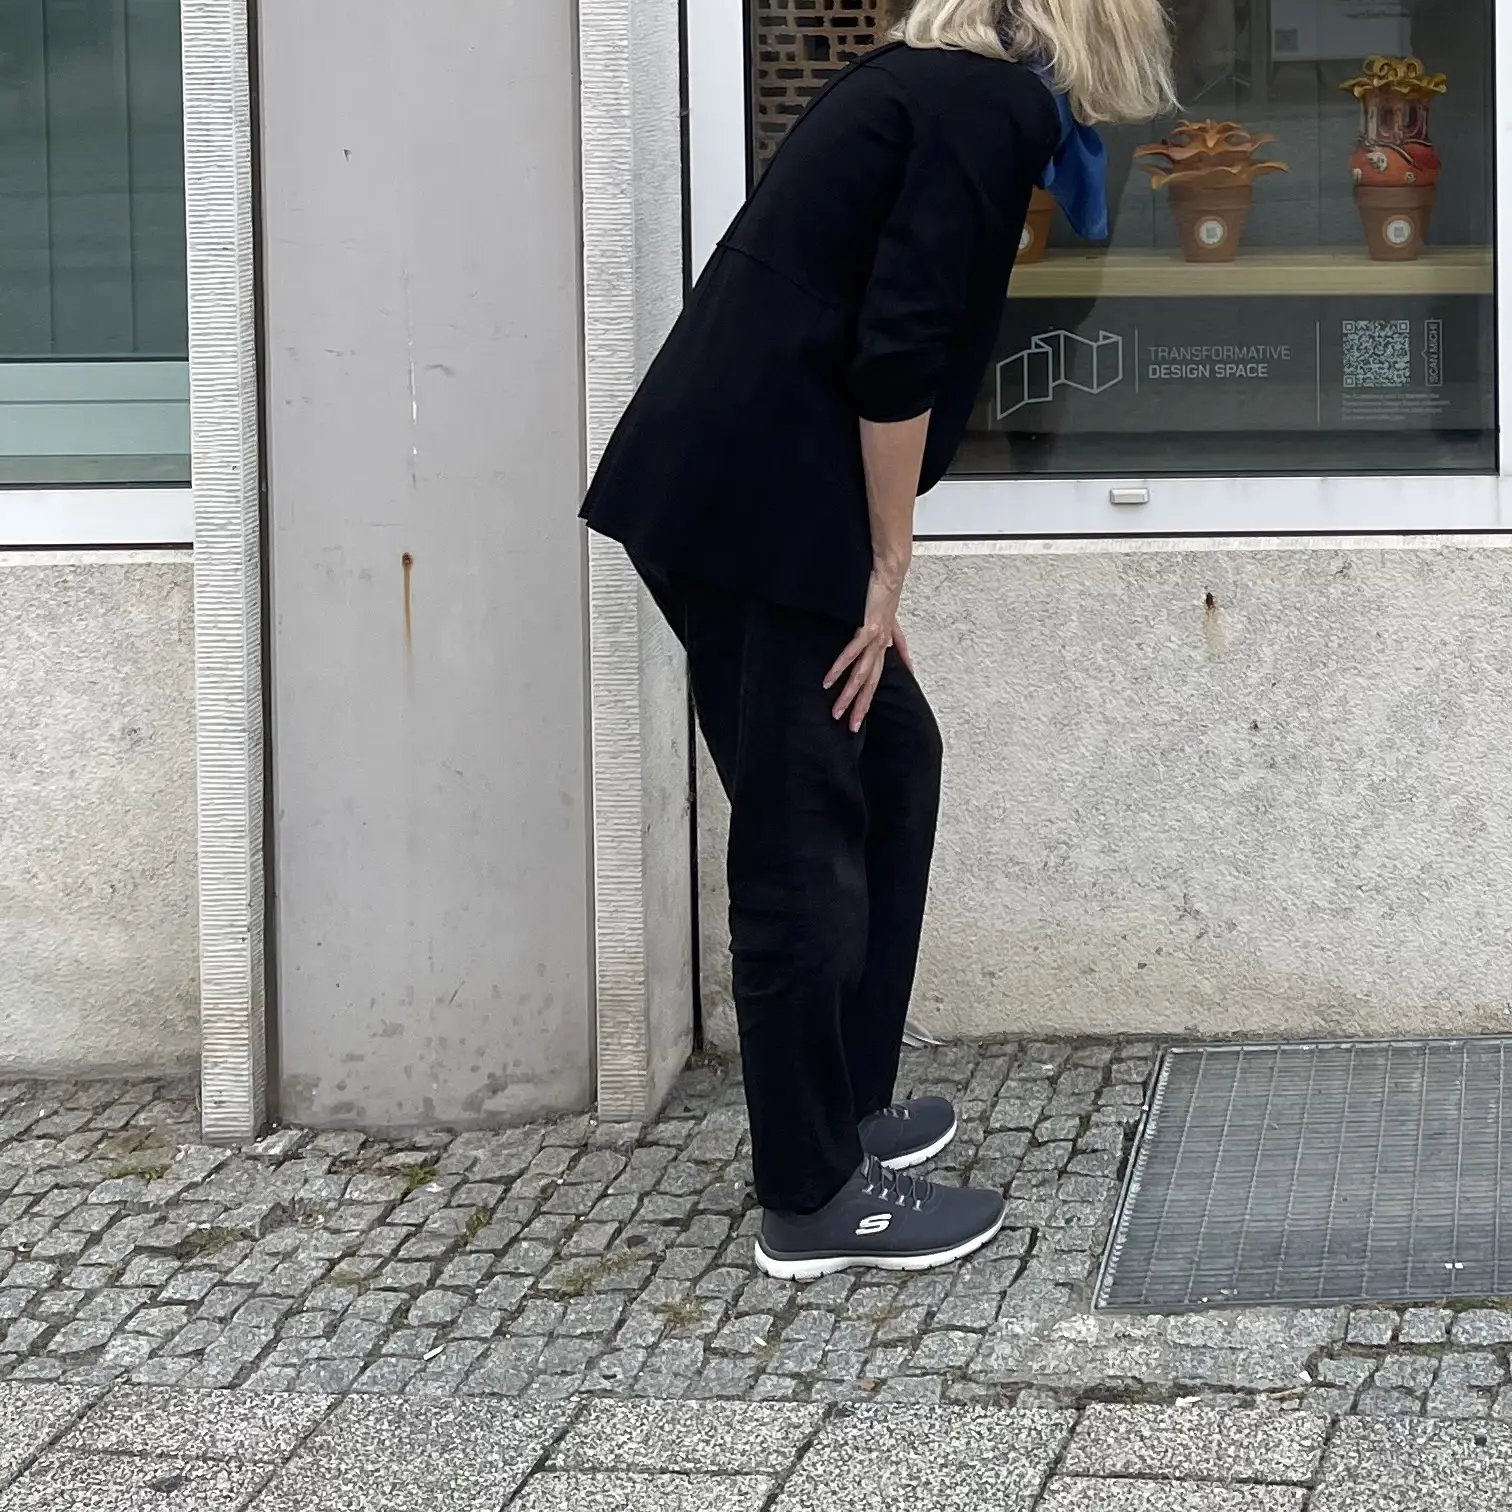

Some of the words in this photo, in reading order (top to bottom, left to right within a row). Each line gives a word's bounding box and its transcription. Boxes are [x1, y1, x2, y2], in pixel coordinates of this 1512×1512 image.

[1148, 345, 1291, 361] TRANSFORMATIVE
[1149, 364, 1210, 379] DESIGN
[1215, 363, 1268, 378] SPACE
